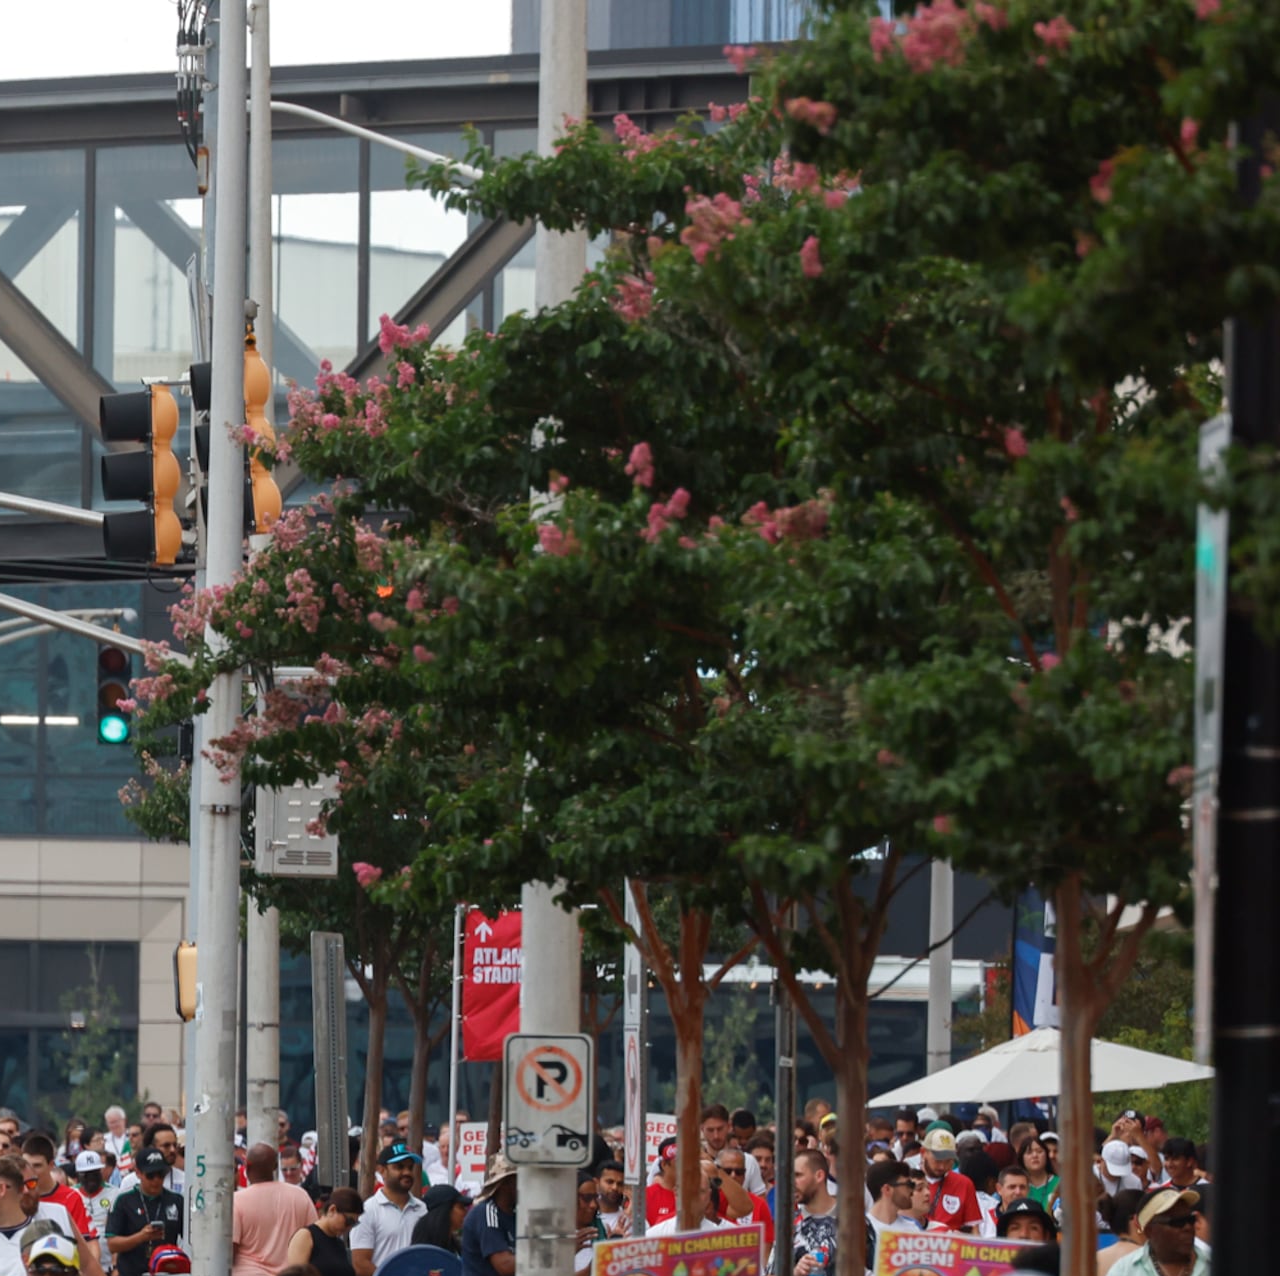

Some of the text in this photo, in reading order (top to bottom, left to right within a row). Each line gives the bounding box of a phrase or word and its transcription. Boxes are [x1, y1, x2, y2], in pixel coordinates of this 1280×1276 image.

[473, 947, 522, 965] ATLAN
[473, 966, 522, 984] STADI
[463, 1130, 487, 1143] GE
[645, 1120, 679, 1135] GEO
[196, 1155, 206, 1177] 5
[195, 1188, 206, 1210] 6
[612, 1240, 660, 1259] NOW
[668, 1233, 758, 1256] IN CHAMBLEE!
[898, 1237, 952, 1252] NOW
[960, 1245, 977, 1259] IN
[606, 1254, 663, 1276] OPEN!
[891, 1252, 955, 1267] OPEN!
